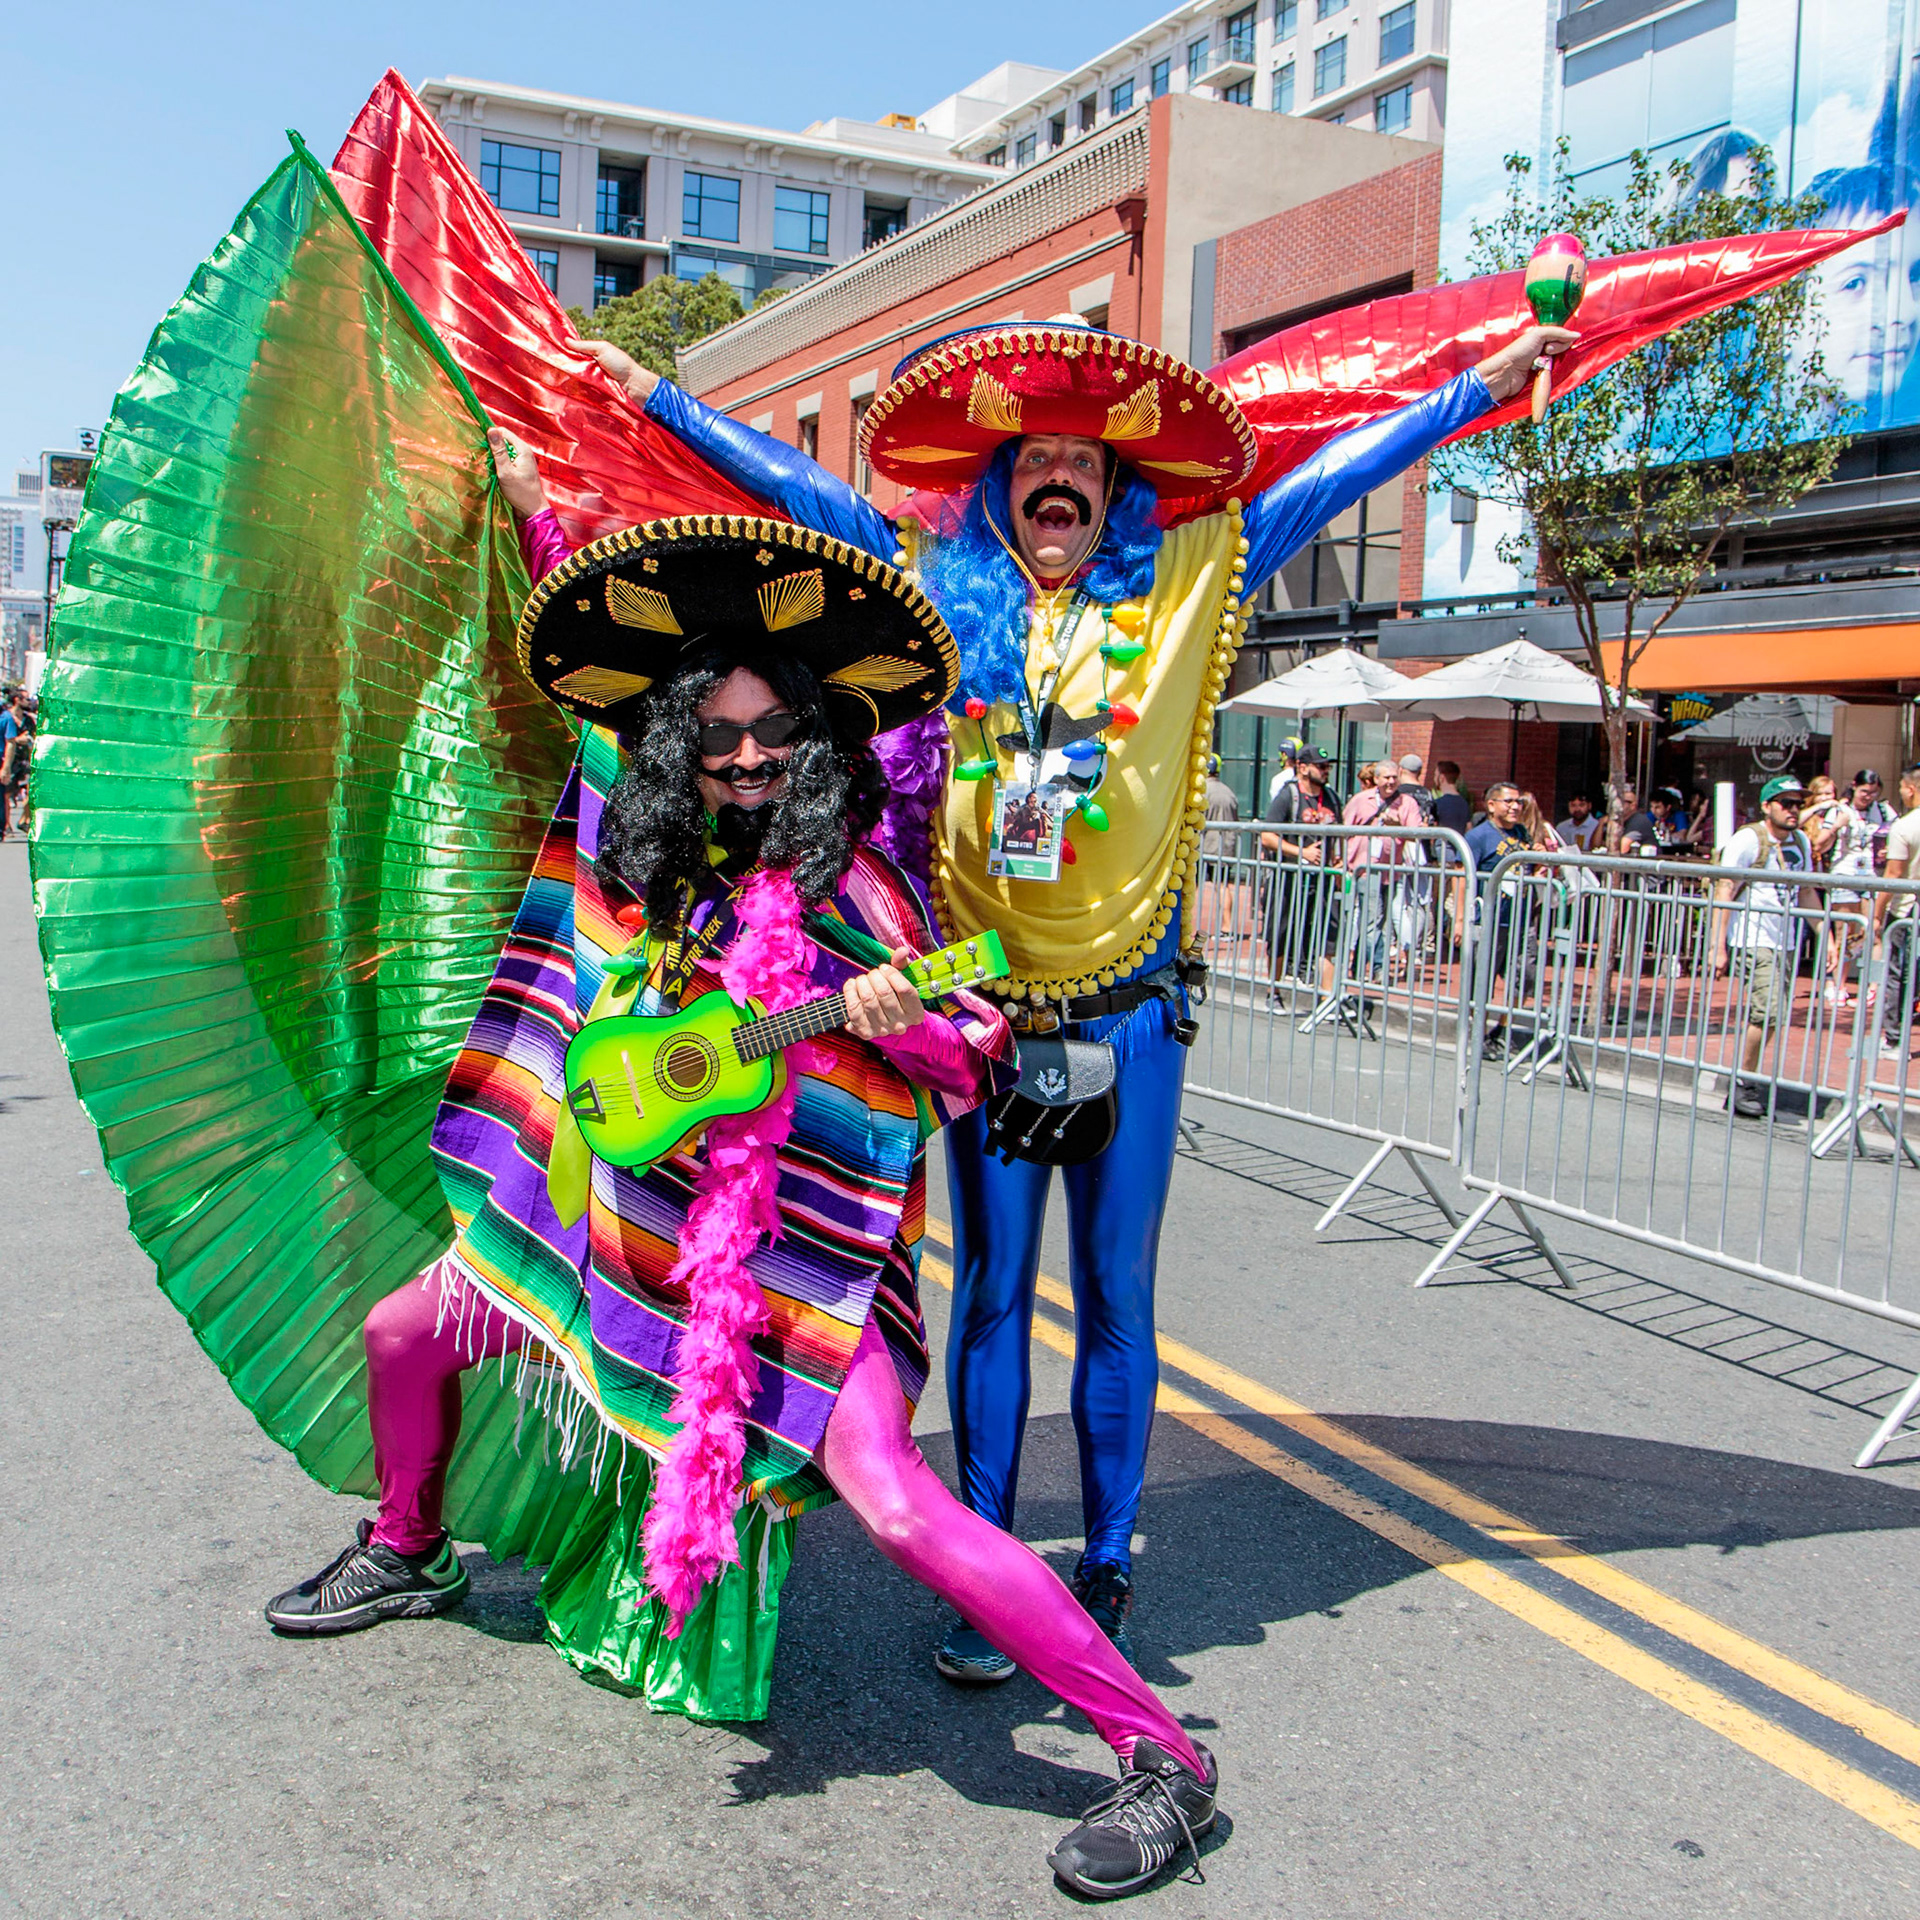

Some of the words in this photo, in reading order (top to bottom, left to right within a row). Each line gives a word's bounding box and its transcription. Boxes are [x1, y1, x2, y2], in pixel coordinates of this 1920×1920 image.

[1671, 699, 1714, 722] WHAT!
[1737, 726, 1775, 747] Hard
[1774, 725, 1810, 750] Rock
[1761, 751, 1785, 760] HOTEL
[1749, 774, 1766, 784] SAN
[665, 941, 682, 971] STAR
[679, 944, 704, 978] STAR
[698, 915, 724, 947] TREK
